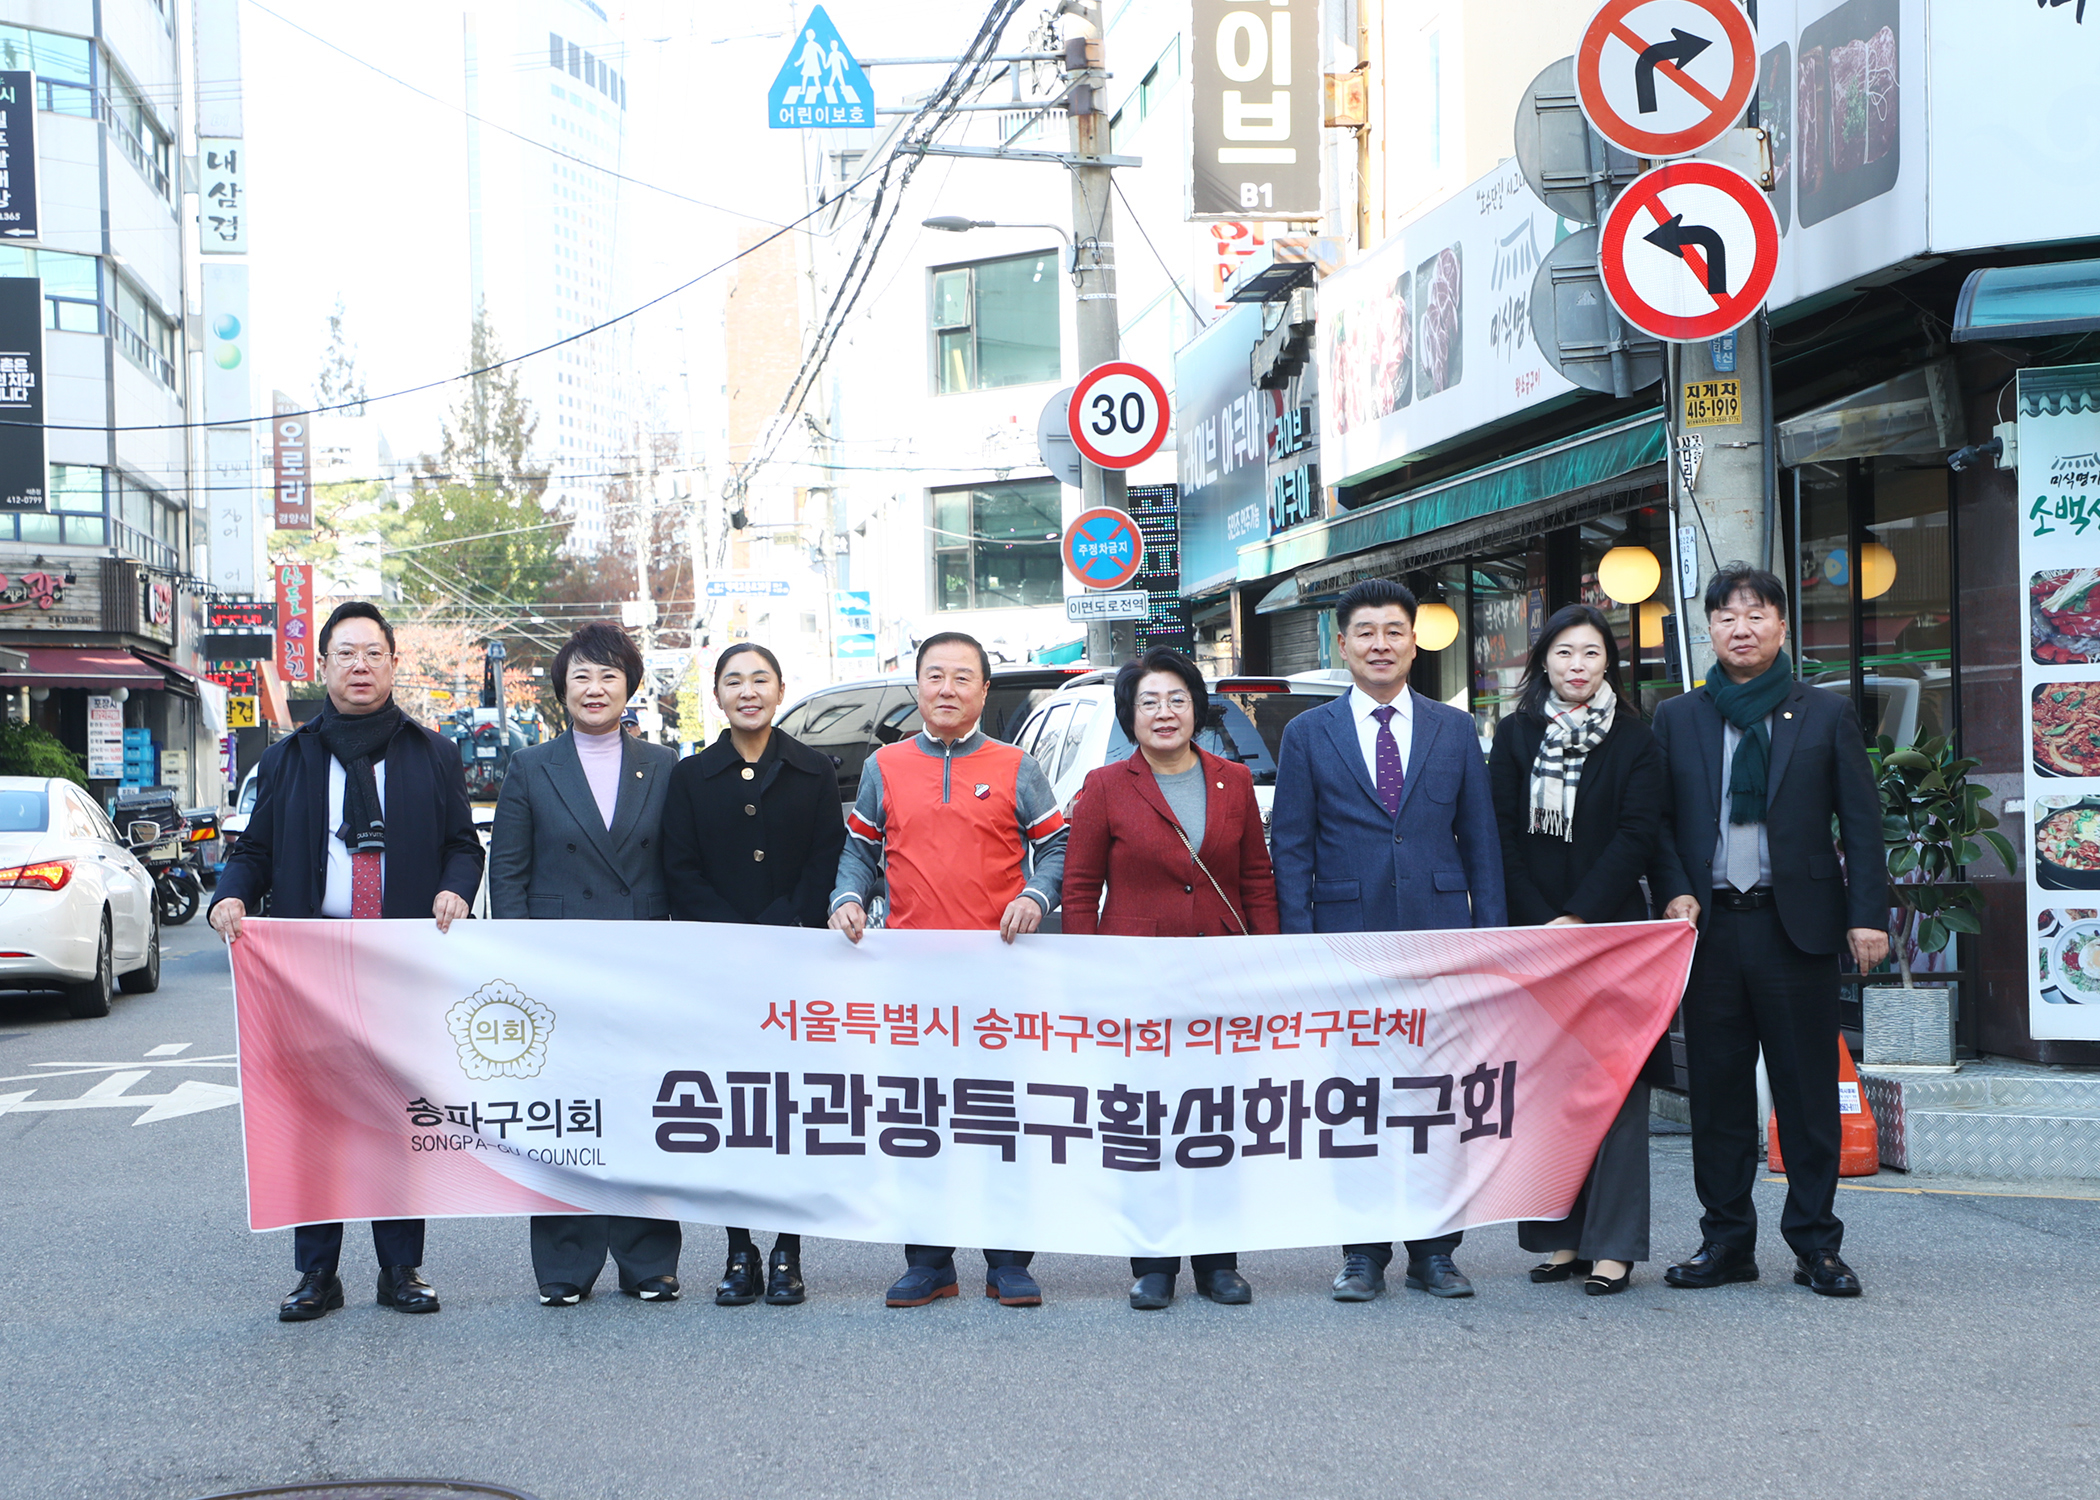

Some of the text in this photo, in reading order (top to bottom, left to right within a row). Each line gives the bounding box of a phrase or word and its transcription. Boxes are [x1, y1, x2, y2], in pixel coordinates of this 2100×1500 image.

[1215, 0, 1297, 164] 이브
[779, 106, 865, 125] 어린이보호
[1240, 182, 1273, 208] B1
[1490, 291, 1534, 363] 미식명
[8, 373, 35, 387] 치킨
[1687, 383, 1737, 398] 지게차
[0, 387, 28, 401] 니다
[1091, 392, 1145, 436] 30
[1687, 398, 1738, 418] 415-1919
[1184, 387, 1260, 497] 라이브 아쿠아
[1275, 408, 1303, 459] 라이브
[279, 421, 306, 506] 오로라
[6, 496, 43, 505] 412-0799
[1274, 464, 1312, 528] 아쿠아
[279, 513, 309, 525] 경양식
[1078, 541, 1128, 557] 주정차금지
[1684, 558, 1690, 574] 6
[1069, 599, 1145, 615] 이면도로전역
[475, 1019, 527, 1045] 의회
[760, 1000, 1427, 1058] 서울특별시 송파구의회 의원연구단체
[406, 1096, 602, 1139] 송파구의회
[652, 1060, 1518, 1172] 송파관광특구활성화연구회
[411, 1134, 606, 1167] SONGPA-GU COUNCIL
